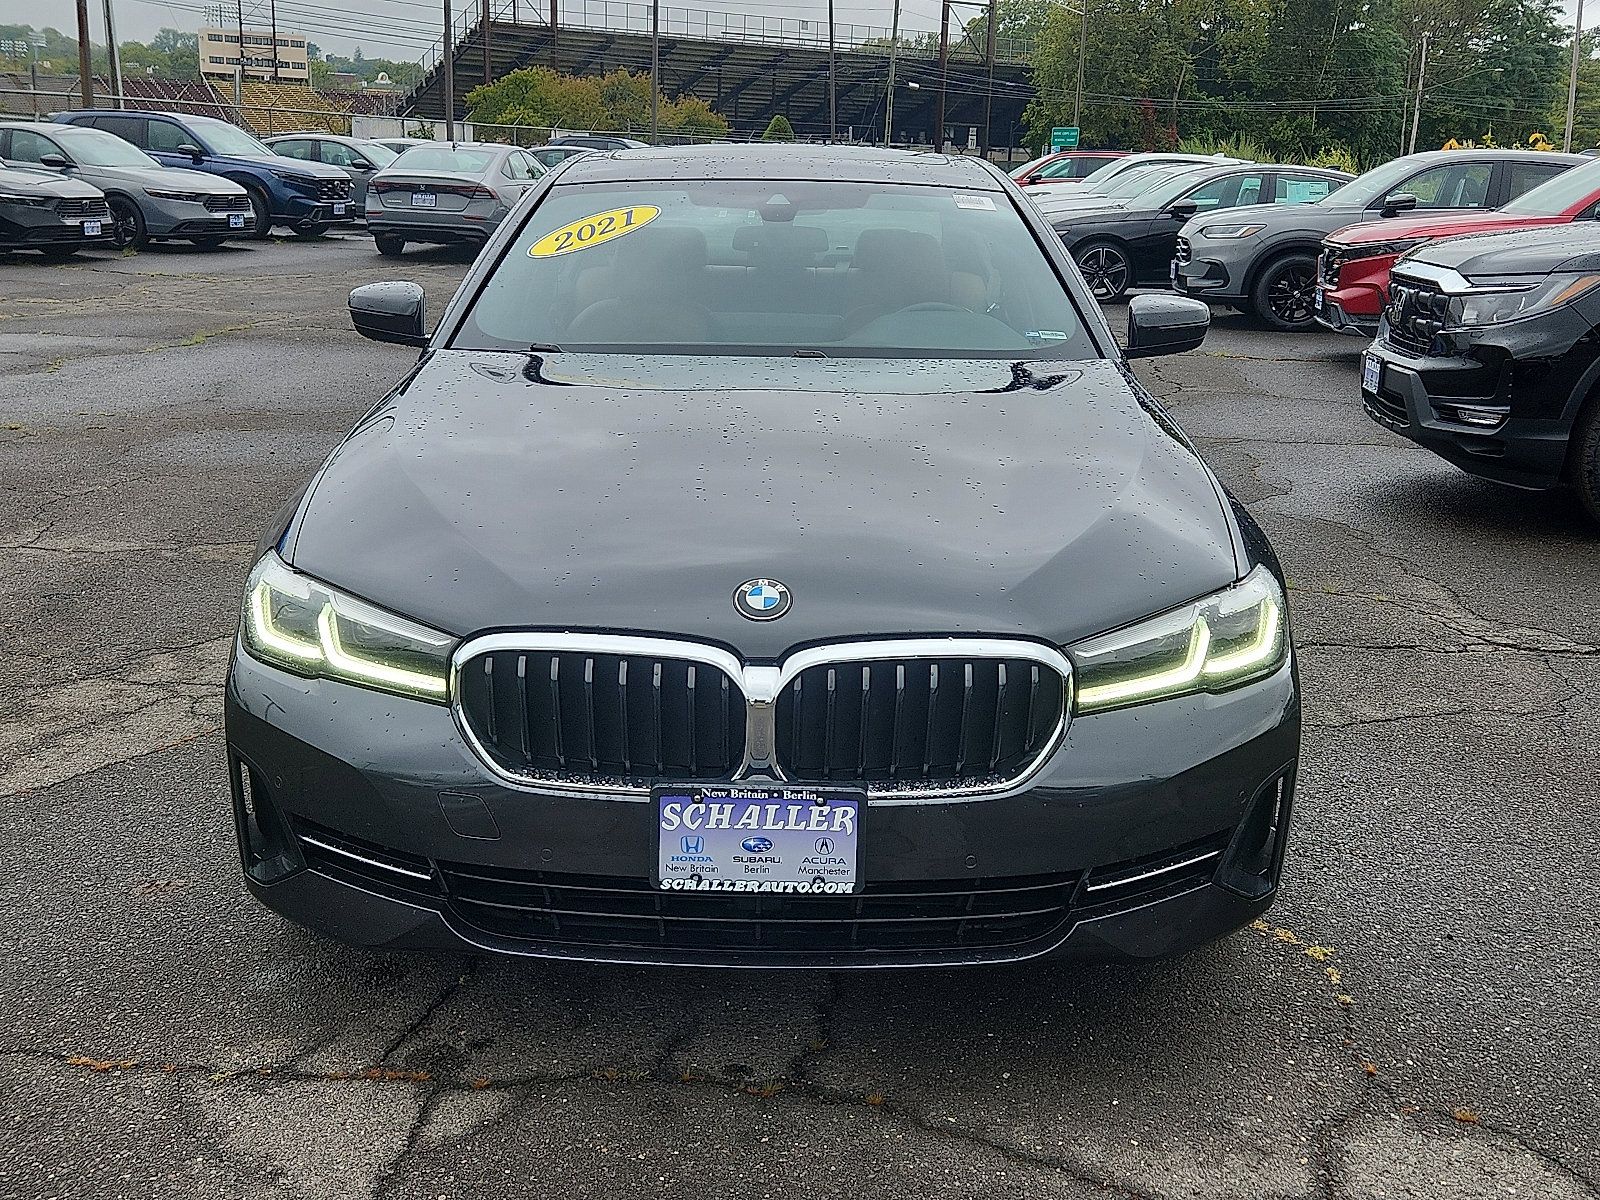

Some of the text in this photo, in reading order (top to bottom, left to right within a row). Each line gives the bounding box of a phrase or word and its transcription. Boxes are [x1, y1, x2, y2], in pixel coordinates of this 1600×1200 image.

[554, 210, 636, 252] 2021
[741, 579, 786, 592] BMW
[701, 789, 817, 800] New Britain Berlin
[661, 803, 855, 835] SCHALLER
[665, 864, 719, 873] New Britain
[744, 865, 769, 874] Berlin
[797, 865, 850, 876] Manchester
[660, 878, 855, 894] SCHALLERAUTO.COM
